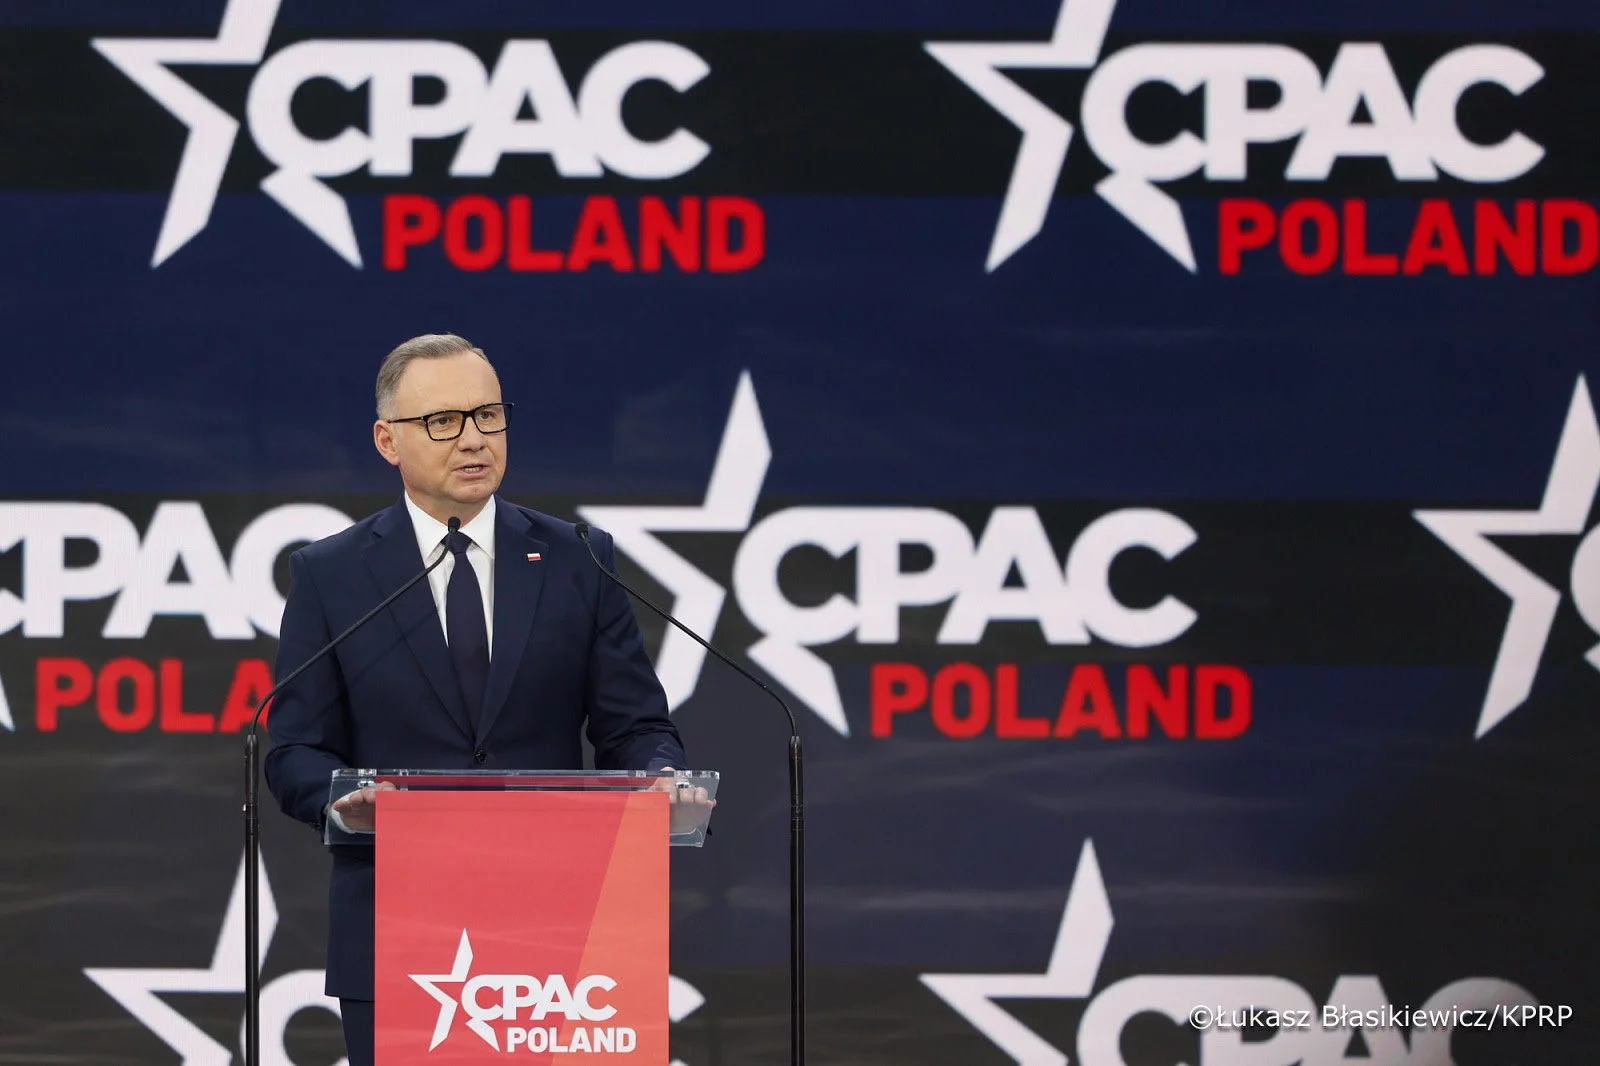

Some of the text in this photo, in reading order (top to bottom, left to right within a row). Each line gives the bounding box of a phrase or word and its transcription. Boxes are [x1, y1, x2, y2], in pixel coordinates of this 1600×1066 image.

[246, 39, 712, 180] CPAC
[1080, 42, 1546, 183] CPAC
[382, 194, 766, 273] POLAND
[1217, 198, 1600, 276] POLAND
[0, 501, 356, 640] PAC
[732, 506, 1198, 648] CPAC
[869, 662, 1253, 739] POLAND
[461, 974, 618, 1021] CPAC
[506, 1027, 637, 1053] POLAND
